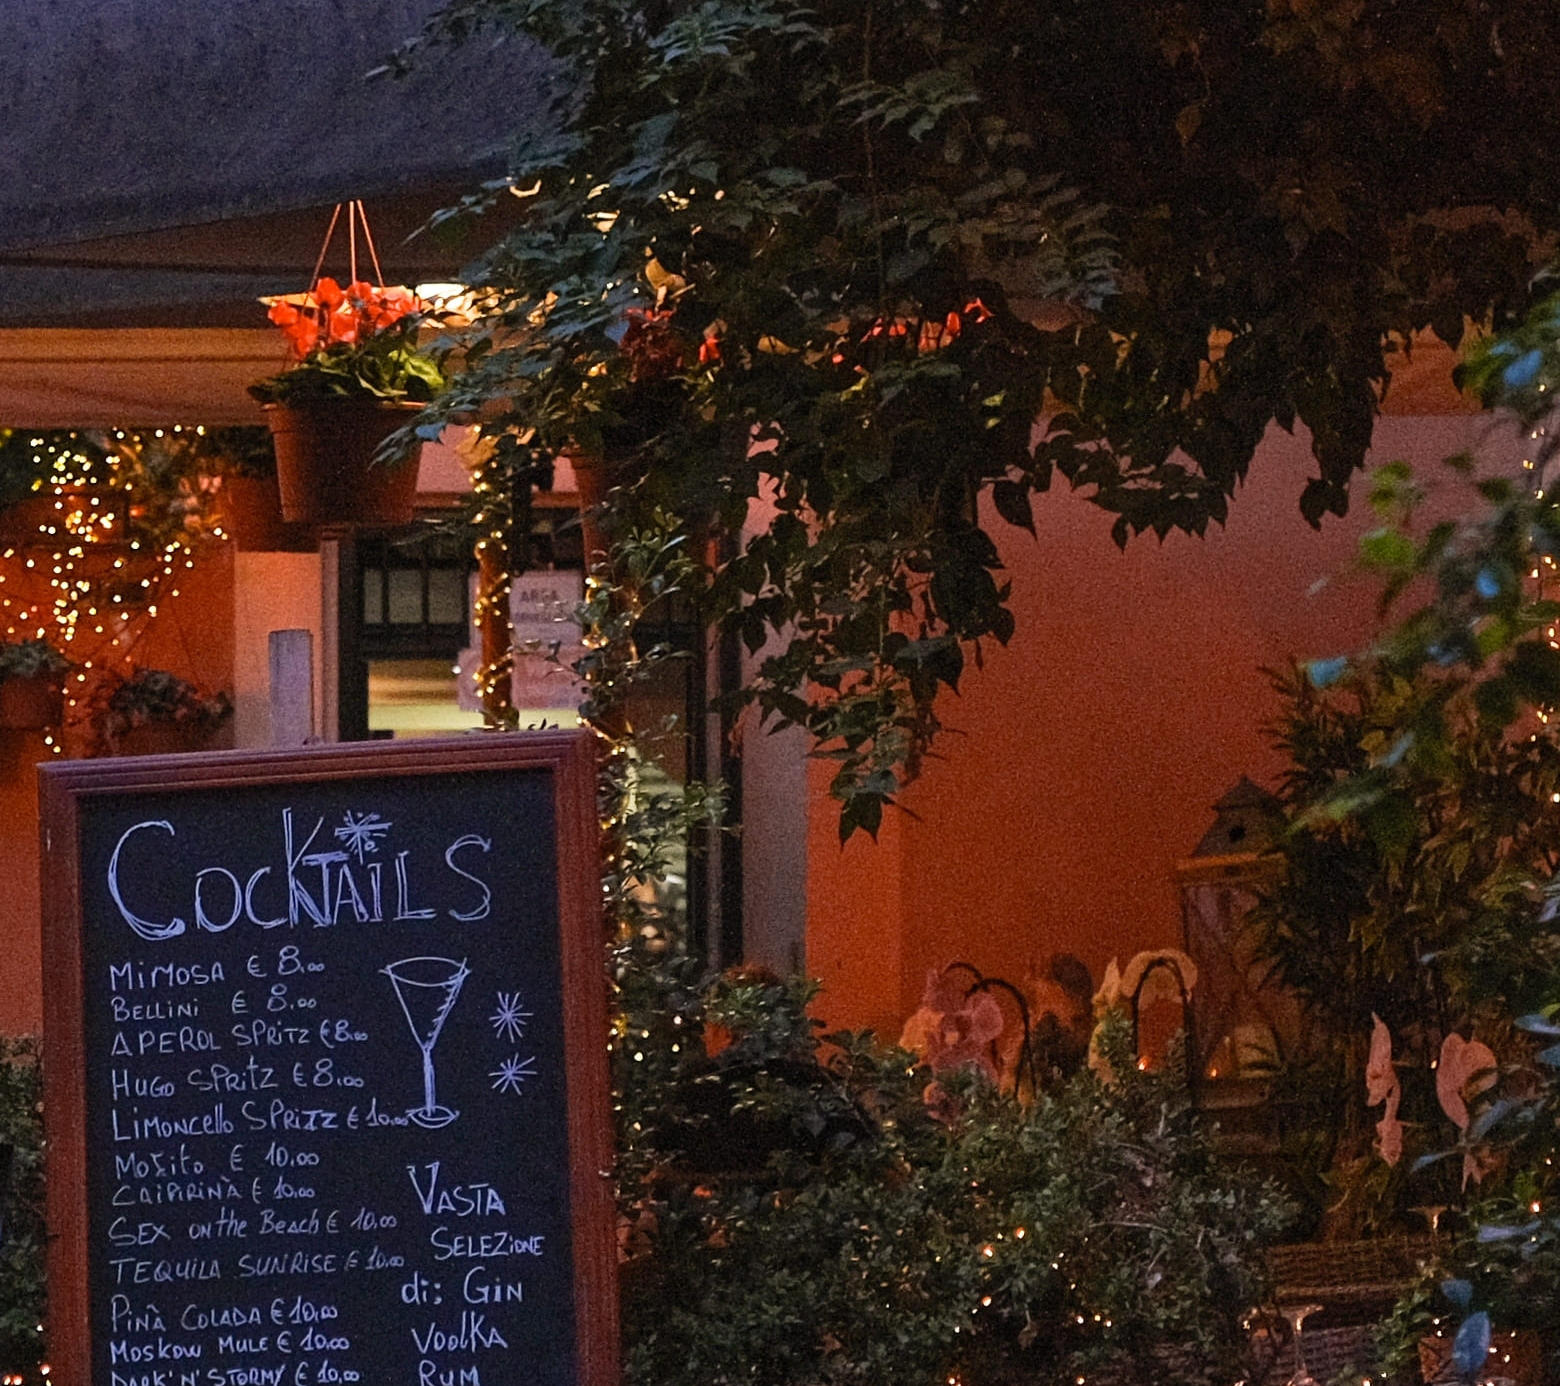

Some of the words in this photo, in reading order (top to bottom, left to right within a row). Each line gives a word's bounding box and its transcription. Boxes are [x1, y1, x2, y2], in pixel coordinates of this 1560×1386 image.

[247, 955, 267, 977] €
[232, 990, 248, 1013] €
[112, 1030, 221, 1057] APEROL
[319, 1020, 334, 1048] €
[293, 1062, 307, 1087] €
[347, 1106, 360, 1129] €
[230, 1144, 244, 1171] €
[252, 1177, 261, 1204] €
[406, 1161, 506, 1216] VASTA
[108, 1217, 171, 1247] SEX
[326, 1210, 340, 1233] €
[344, 1250, 360, 1274] €
[270, 1298, 284, 1325] €
[219, 1336, 268, 1354] MULE
[277, 1331, 292, 1354] €
